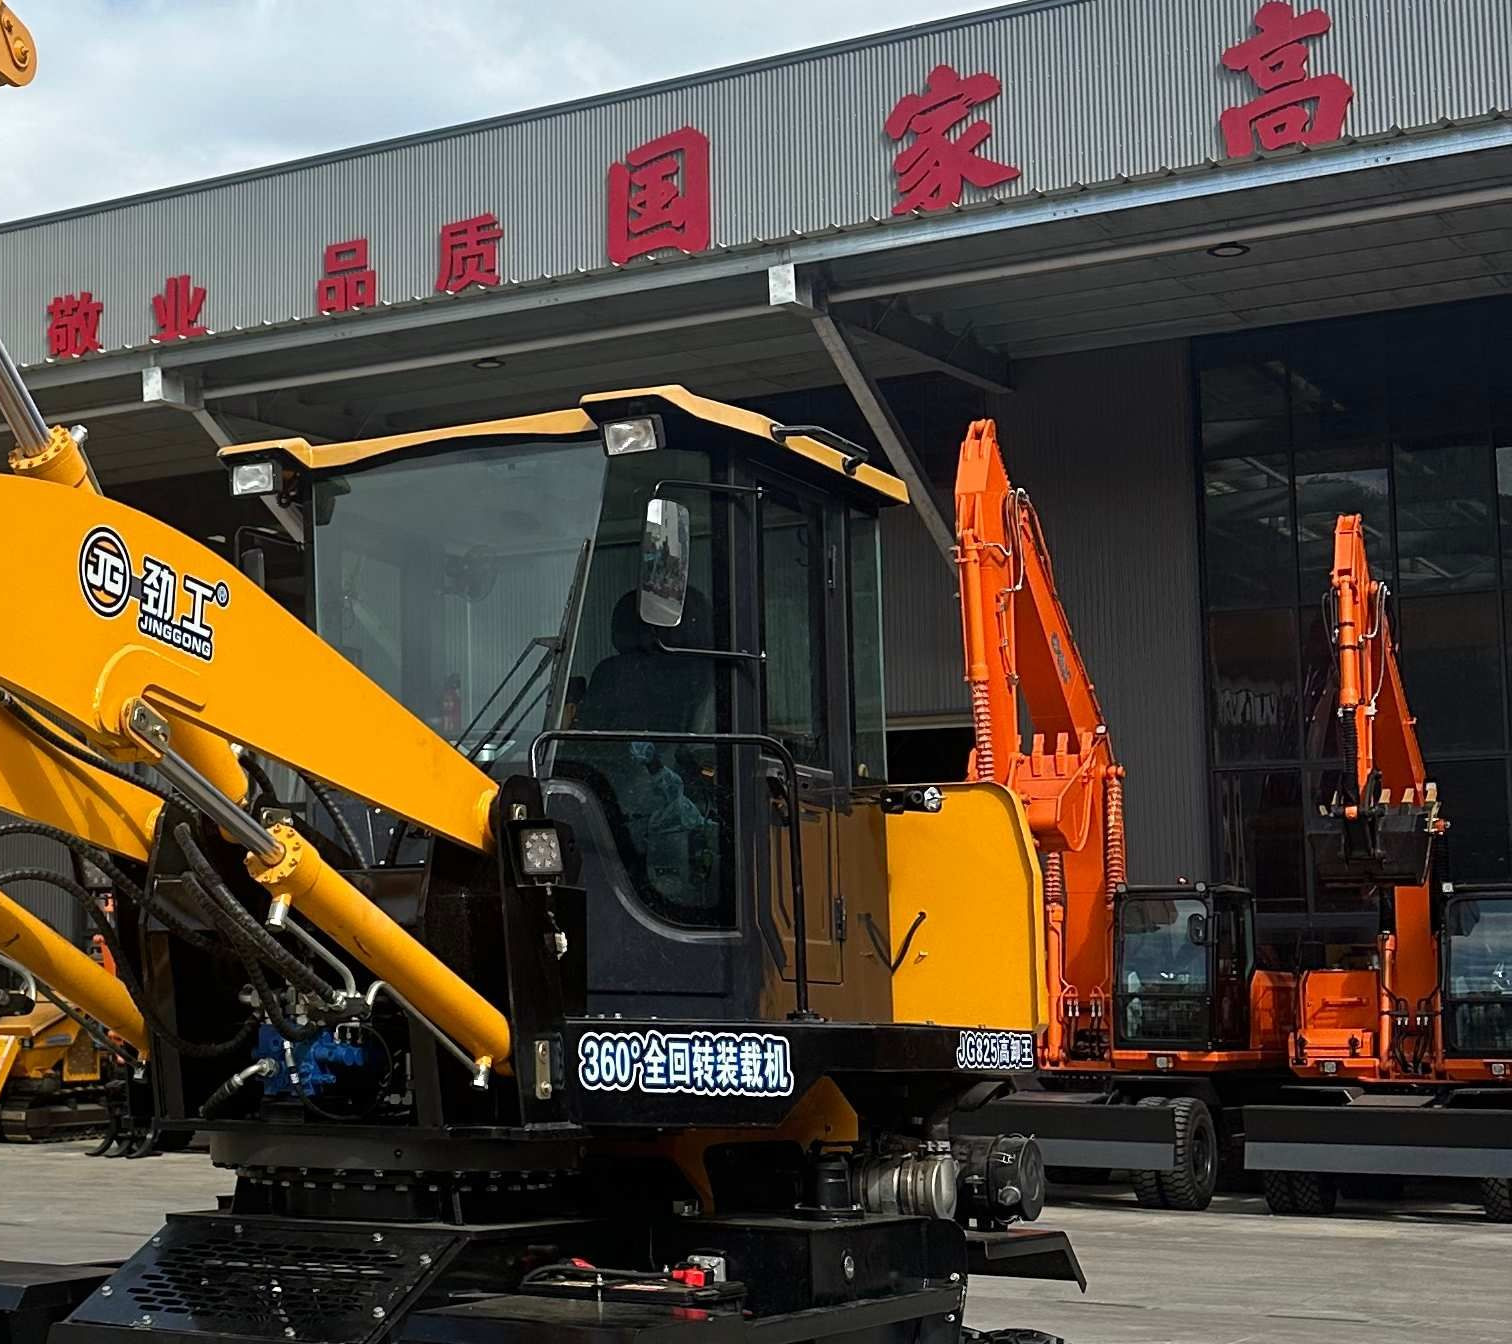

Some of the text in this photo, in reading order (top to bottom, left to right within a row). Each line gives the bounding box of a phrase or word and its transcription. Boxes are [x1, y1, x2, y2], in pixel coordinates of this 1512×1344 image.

[87, 546, 126, 597] JG
[139, 614, 212, 657] JINGGONG
[583, 1039, 789, 1089] 360°全回转装载机
